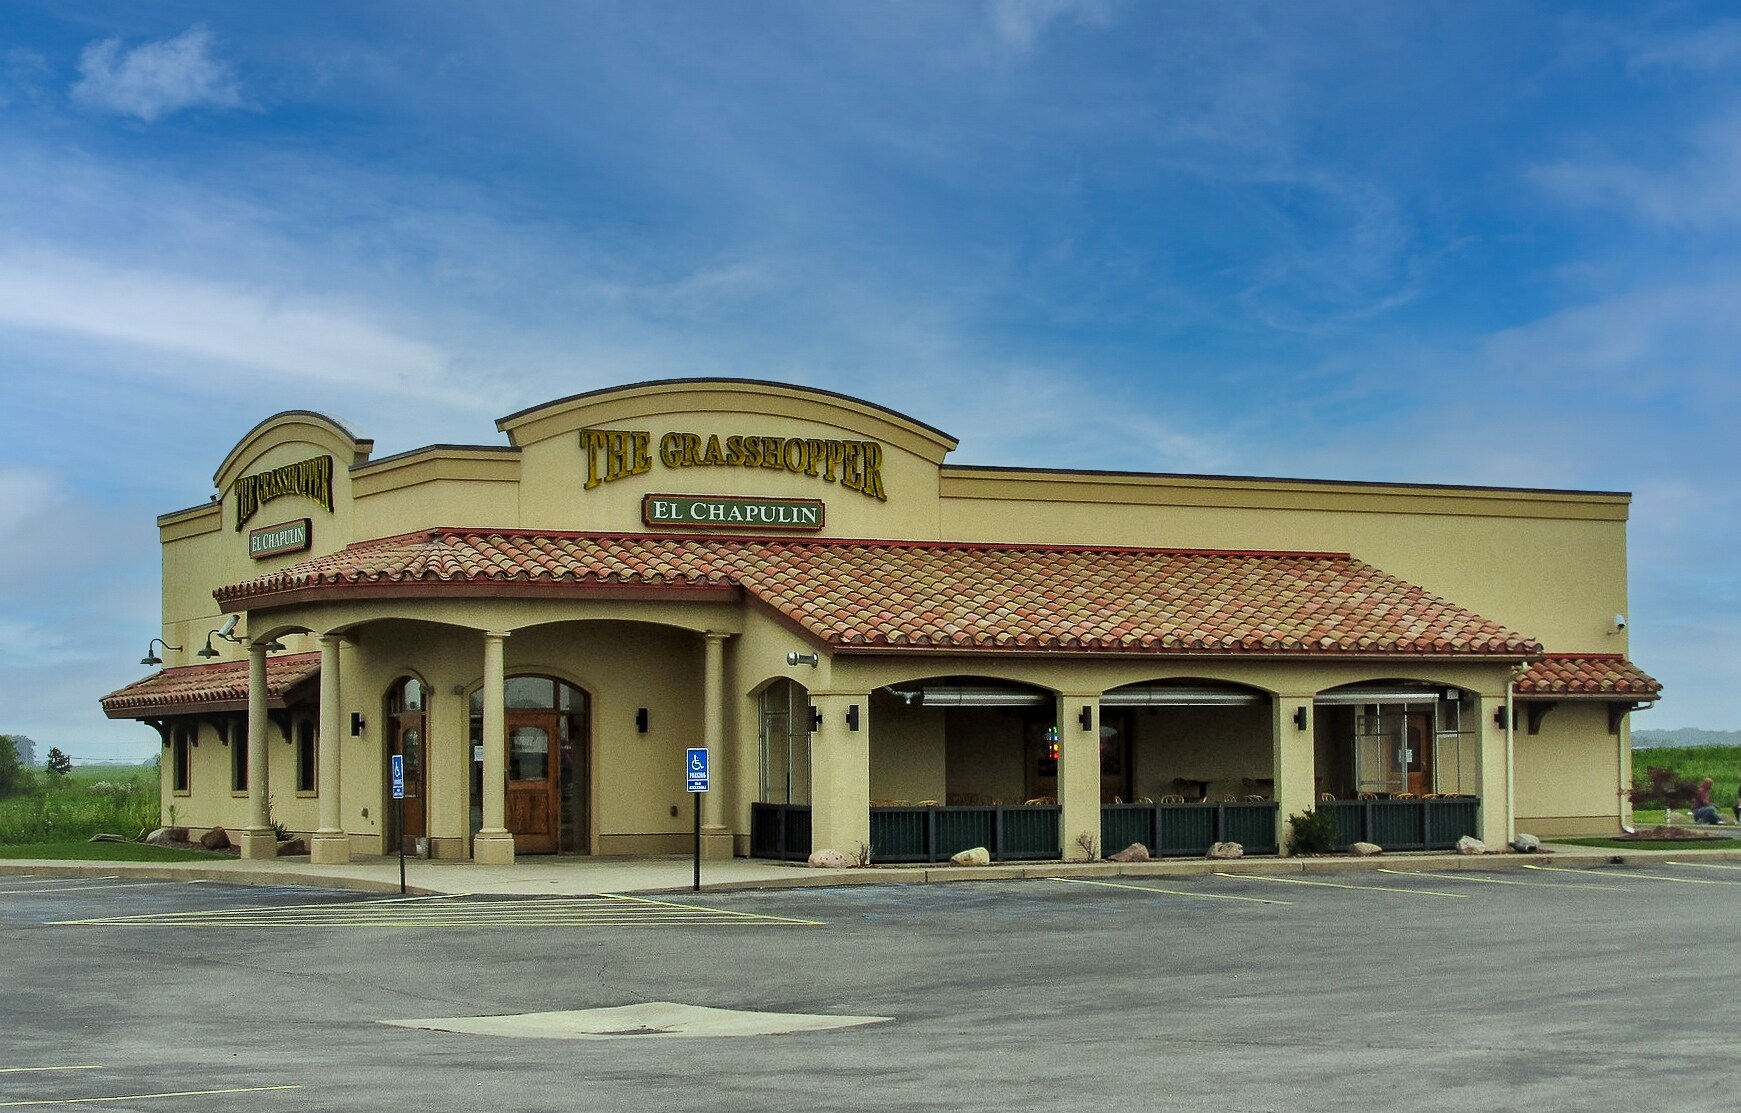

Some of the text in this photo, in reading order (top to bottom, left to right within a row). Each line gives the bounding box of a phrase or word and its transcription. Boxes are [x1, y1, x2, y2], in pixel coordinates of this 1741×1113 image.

[580, 430, 887, 501] THE GRASSHOPPER
[654, 501, 817, 524] EL CHAPULIN
[252, 527, 305, 552] EL CHAPULIN
